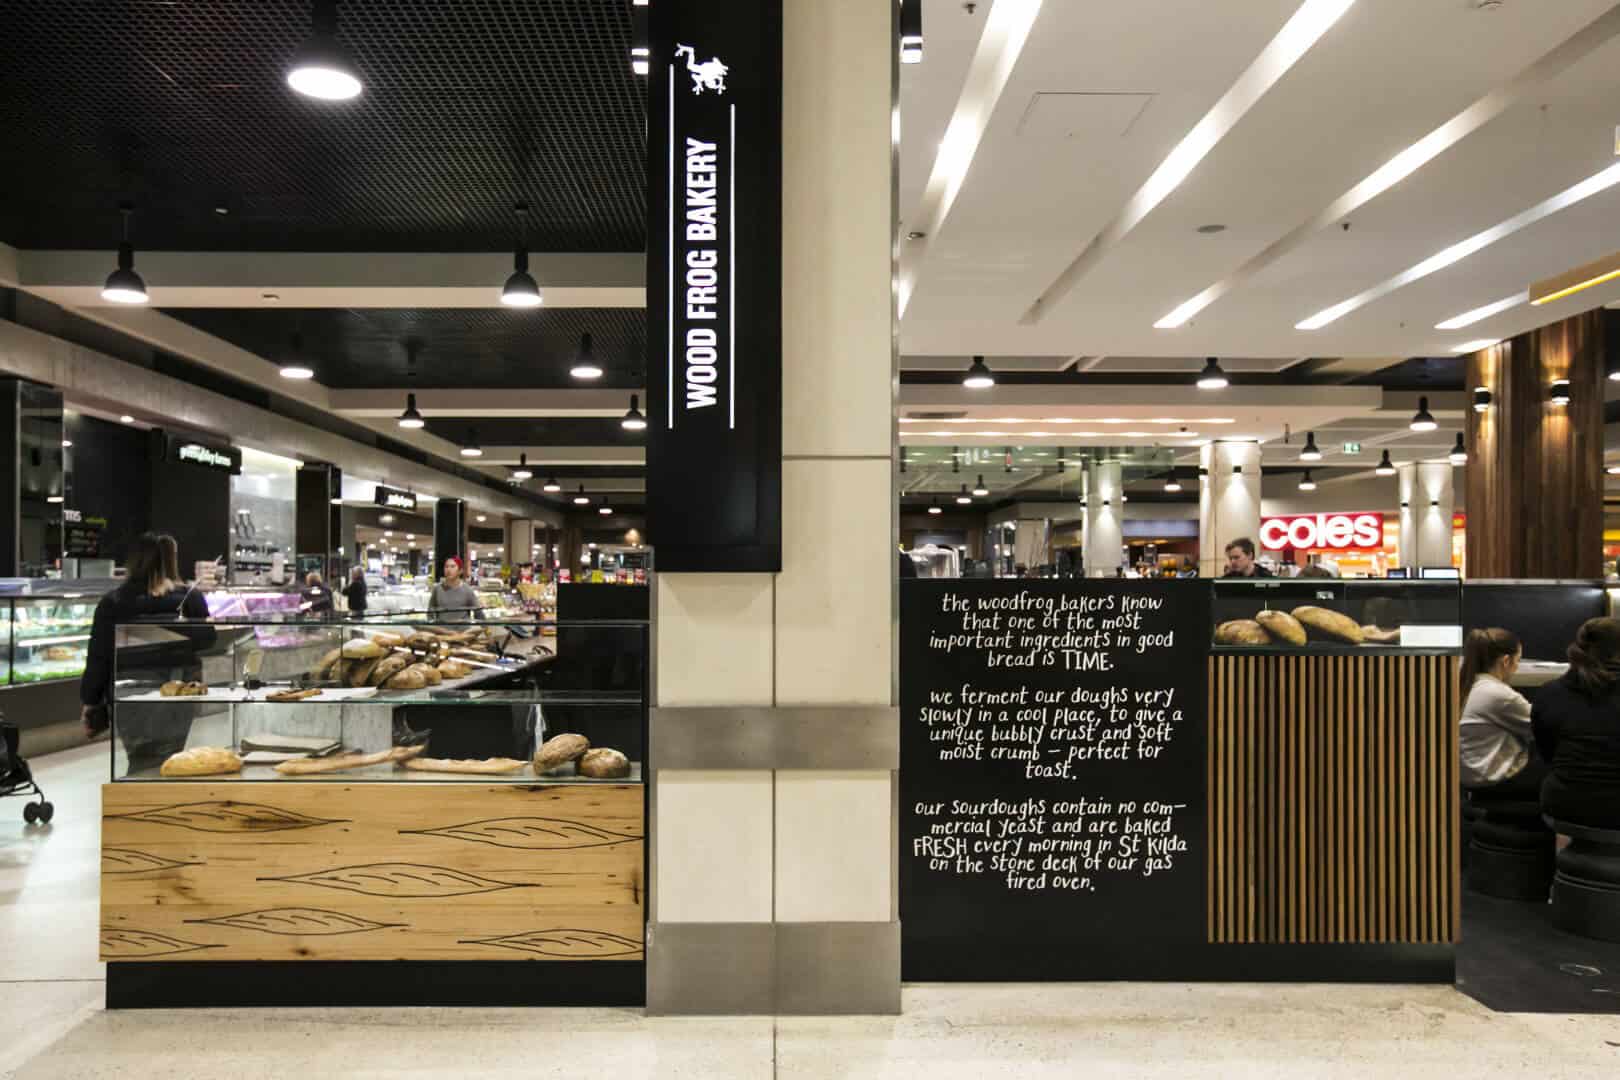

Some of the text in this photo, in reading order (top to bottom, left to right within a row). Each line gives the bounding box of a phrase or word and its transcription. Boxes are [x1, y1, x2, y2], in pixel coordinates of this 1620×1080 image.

[686, 138, 718, 409] WOOD FROG BAKERY
[1260, 513, 1379, 550] coles
[943, 591, 1162, 616] the woodfrog bakers know
[963, 610, 1142, 630] that one of the most
[930, 630, 1173, 653] important ingredients in good
[987, 649, 1113, 671] bread is TIME.
[931, 684, 1174, 707] we ferment our doughs very
[920, 705, 1182, 727] slowly in a cool place, to give a
[930, 722, 1173, 744] unique bubbly crust and soft
[940, 742, 984, 760] moist
[990, 743, 1040, 761] crumb
[1068, 741, 1131, 762] perfect
[1137, 741, 1163, 760] for
[1026, 760, 1076, 780] toast.
[915, 803, 944, 815] our
[952, 798, 1045, 821] sourdoughs
[1053, 797, 1111, 815] contain
[1118, 802, 1136, 814] no
[931, 816, 1171, 838] mercial yeast and are baked
[913, 836, 967, 857] FRESH
[974, 837, 1023, 856] every
[1028, 834, 1091, 858] morning
[1098, 833, 1112, 852] in
[930, 852, 1173, 875] on the stone deck of our gas
[1006, 872, 1095, 891] fired oven.
